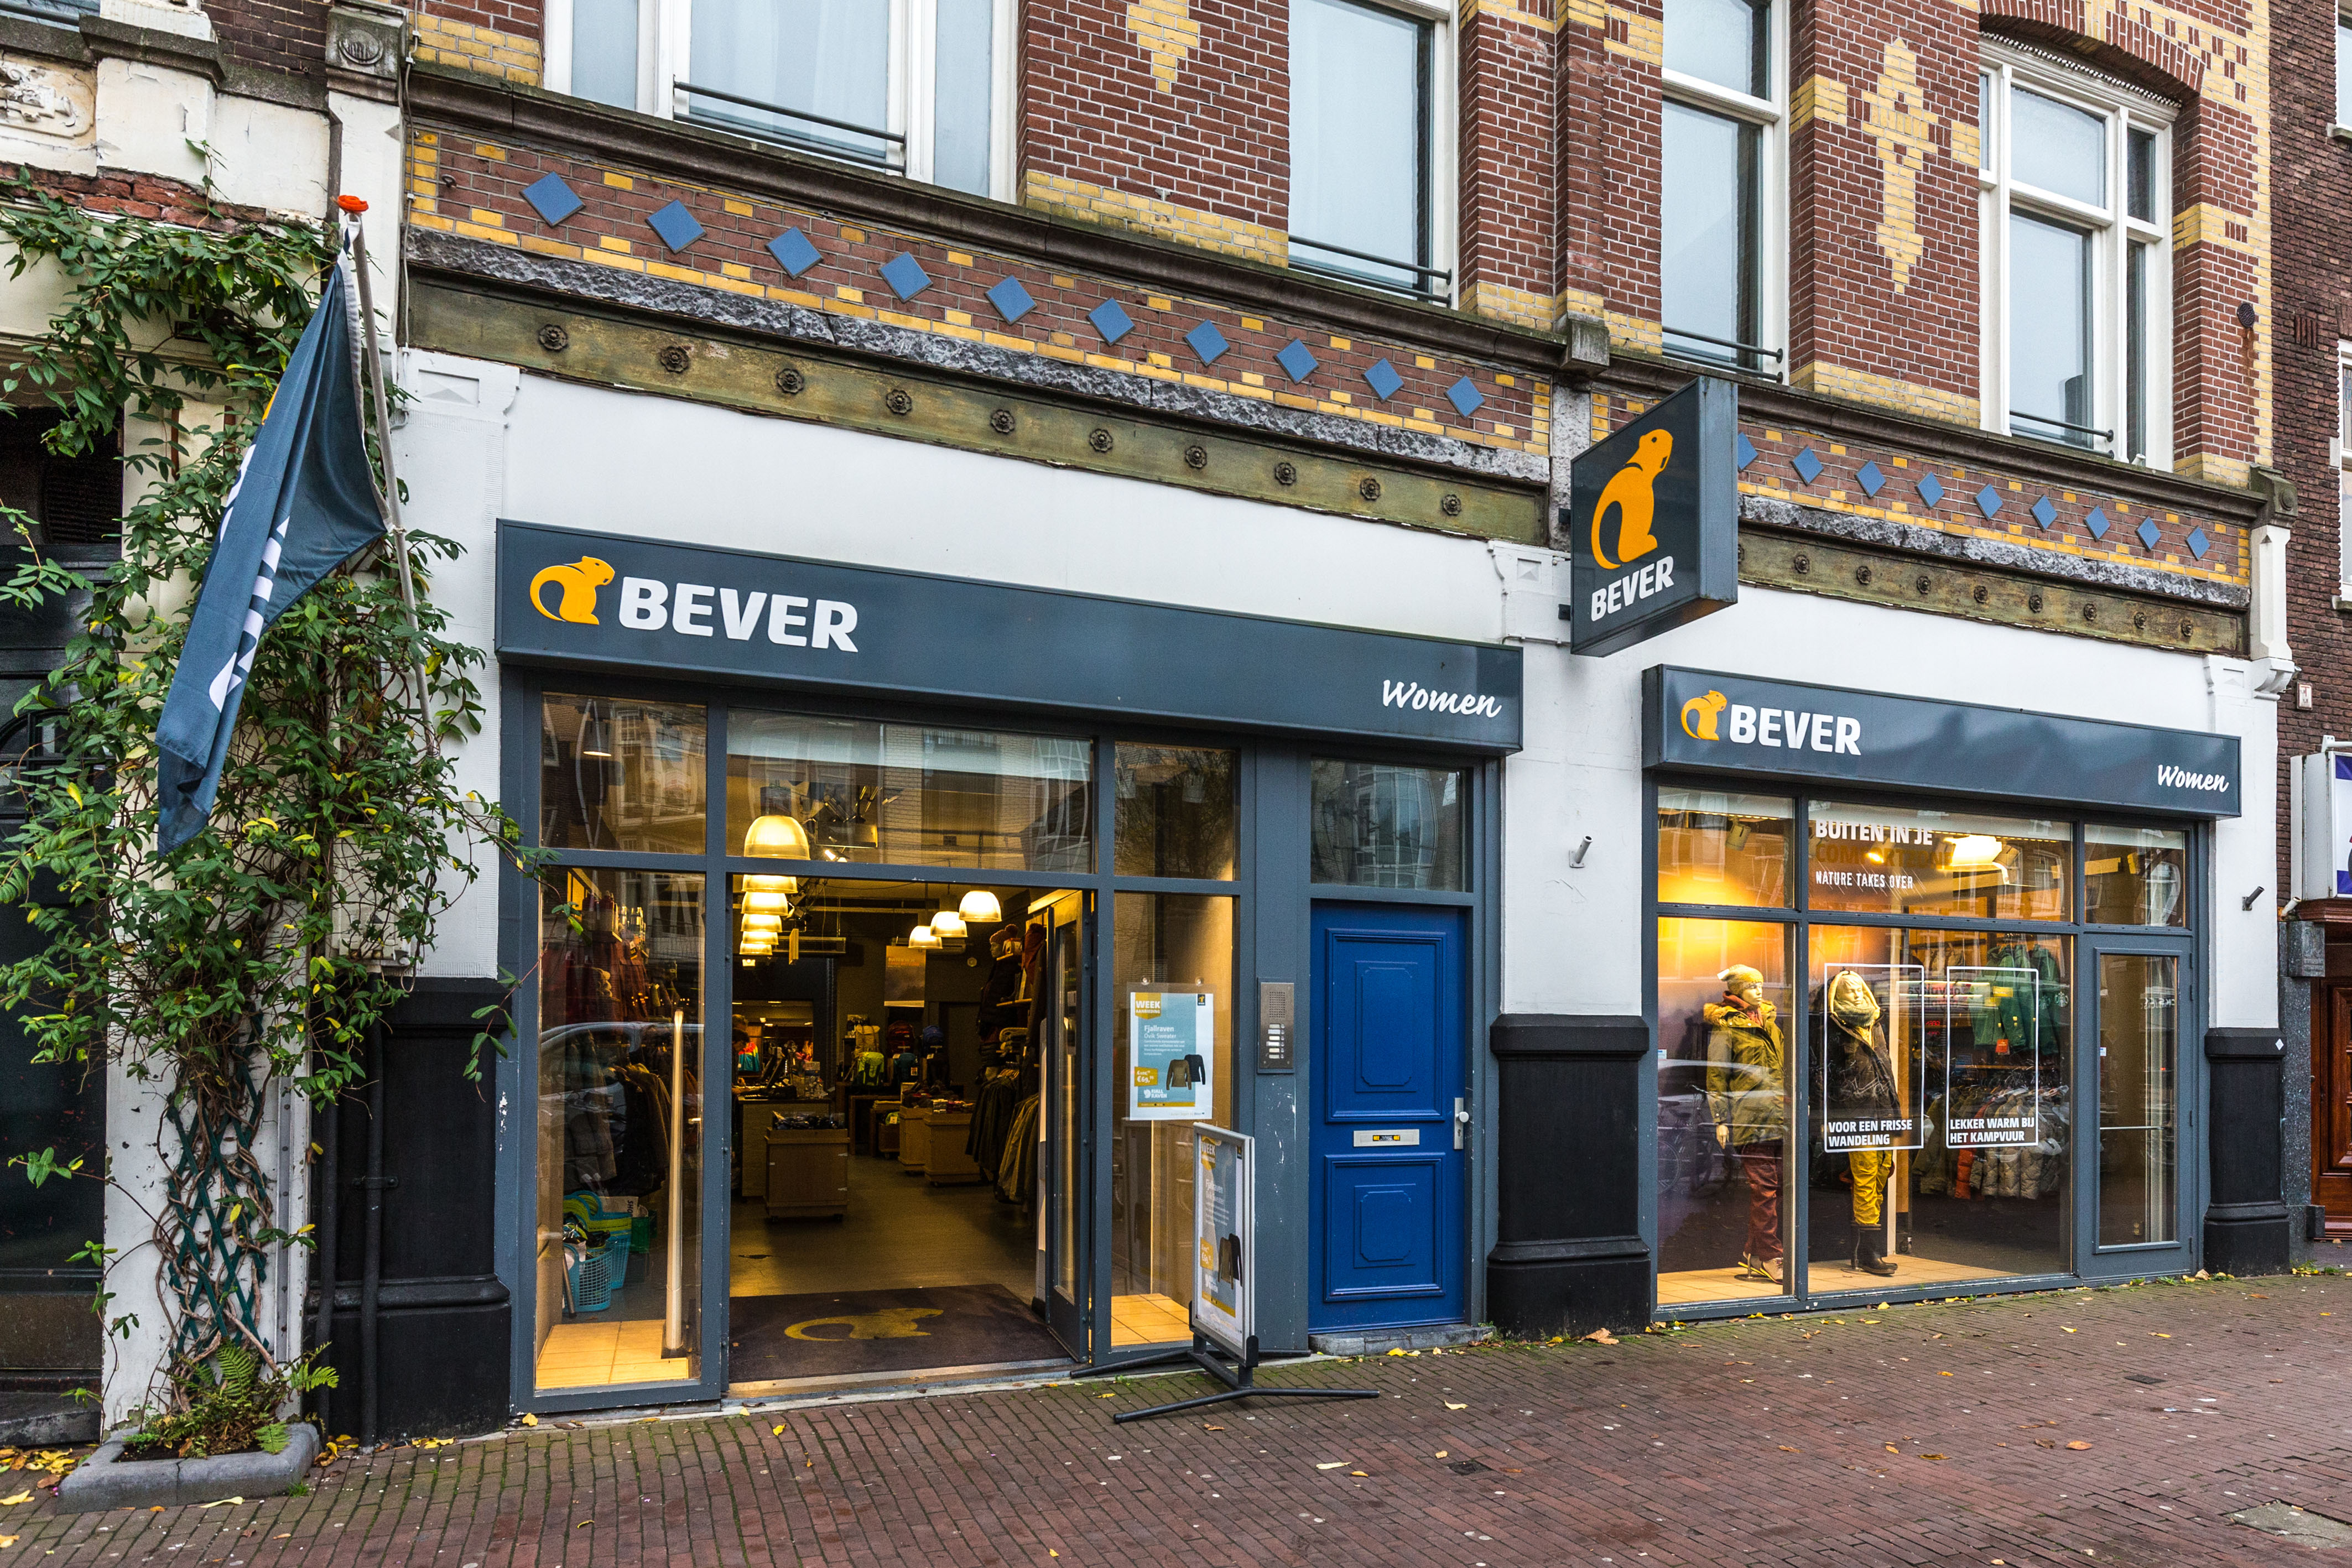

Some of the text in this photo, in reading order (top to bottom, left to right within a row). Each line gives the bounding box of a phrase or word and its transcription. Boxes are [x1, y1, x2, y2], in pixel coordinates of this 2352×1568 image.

[1591, 555, 1674, 622] BEVER
[619, 576, 858, 653] BEVER
[1383, 679, 1502, 718] Women
[1729, 704, 1861, 756] BEVER
[2158, 764, 2229, 793] Women
[1815, 819, 1933, 846] BUITEN IN JE
[1815, 871, 1913, 889] NATURE TAKES OVER
[1136, 1000, 1161, 1008] WEEK
[1828, 1119, 1912, 1133] VOOR EEN FRISSE
[1950, 1117, 2034, 1129] LEKKER WARM BIJ
[1828, 1134, 1890, 1147] WANDELING
[1950, 1131, 2025, 1143] HET KAMPVUUR
